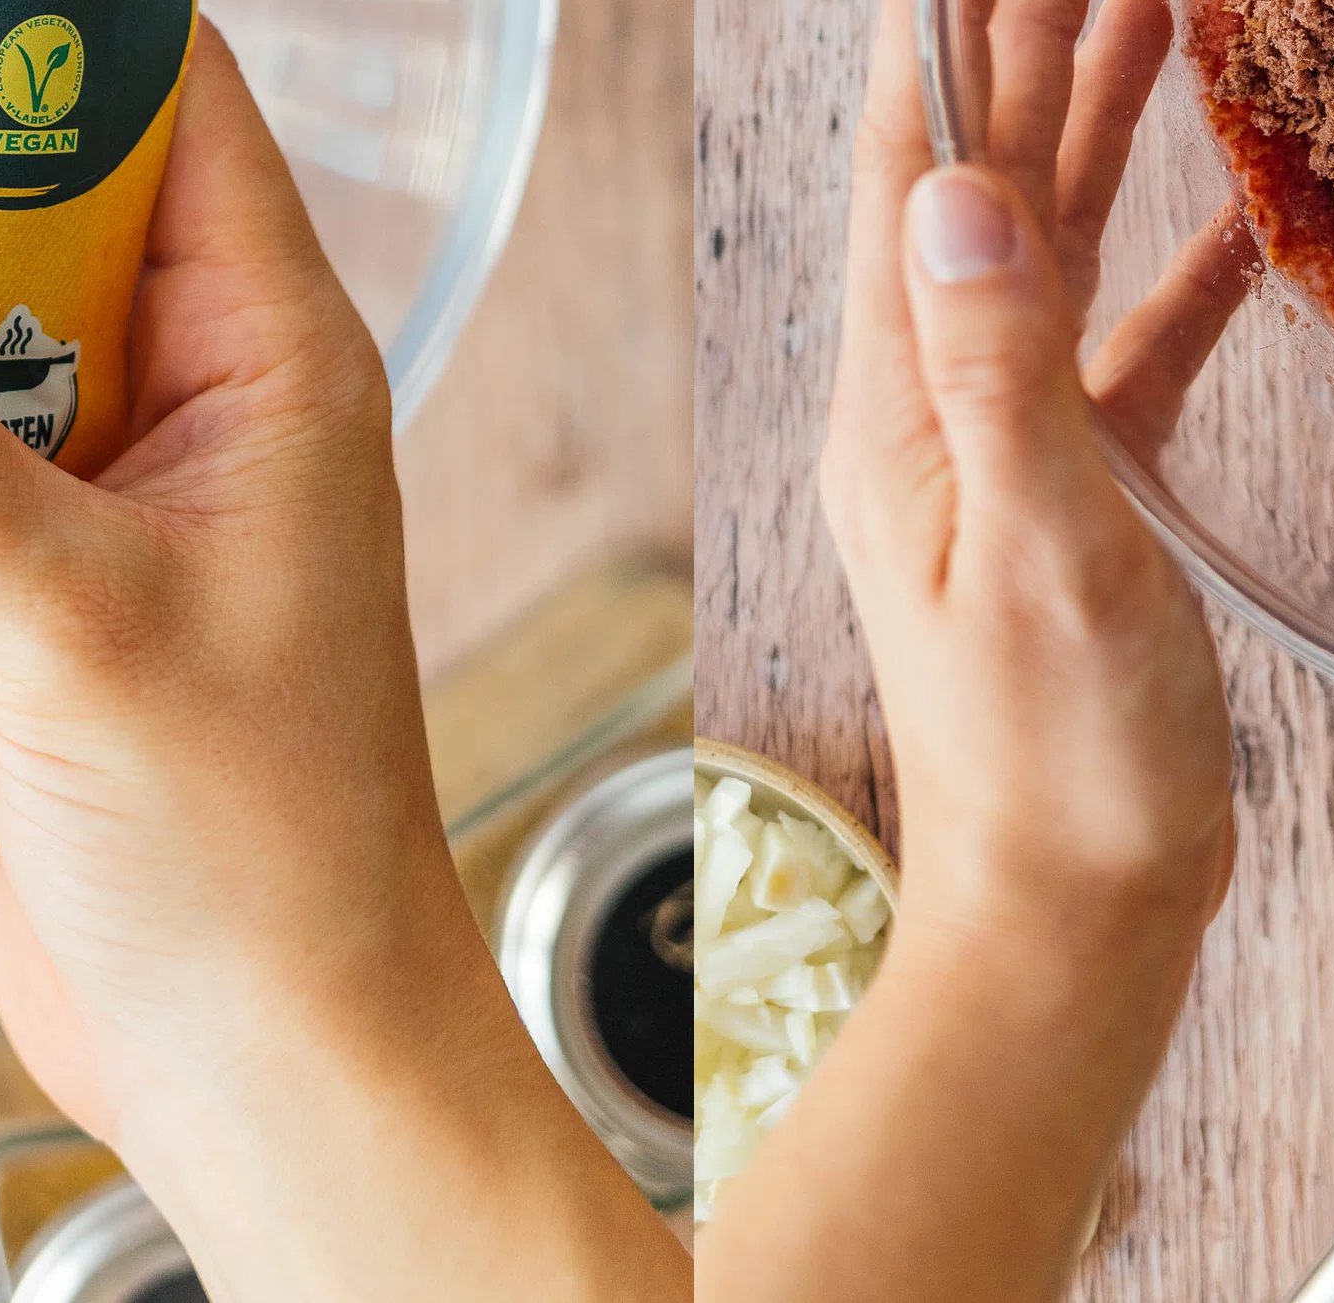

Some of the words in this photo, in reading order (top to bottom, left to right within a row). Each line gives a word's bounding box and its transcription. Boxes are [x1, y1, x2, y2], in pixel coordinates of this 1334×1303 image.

[25, 17, 81, 49] VEGETARIAN
[74, 51, 83, 92] UNION
[5, 101, 70, 124] V-LABEL.EU
[0, 413, 54, 449] TEN
